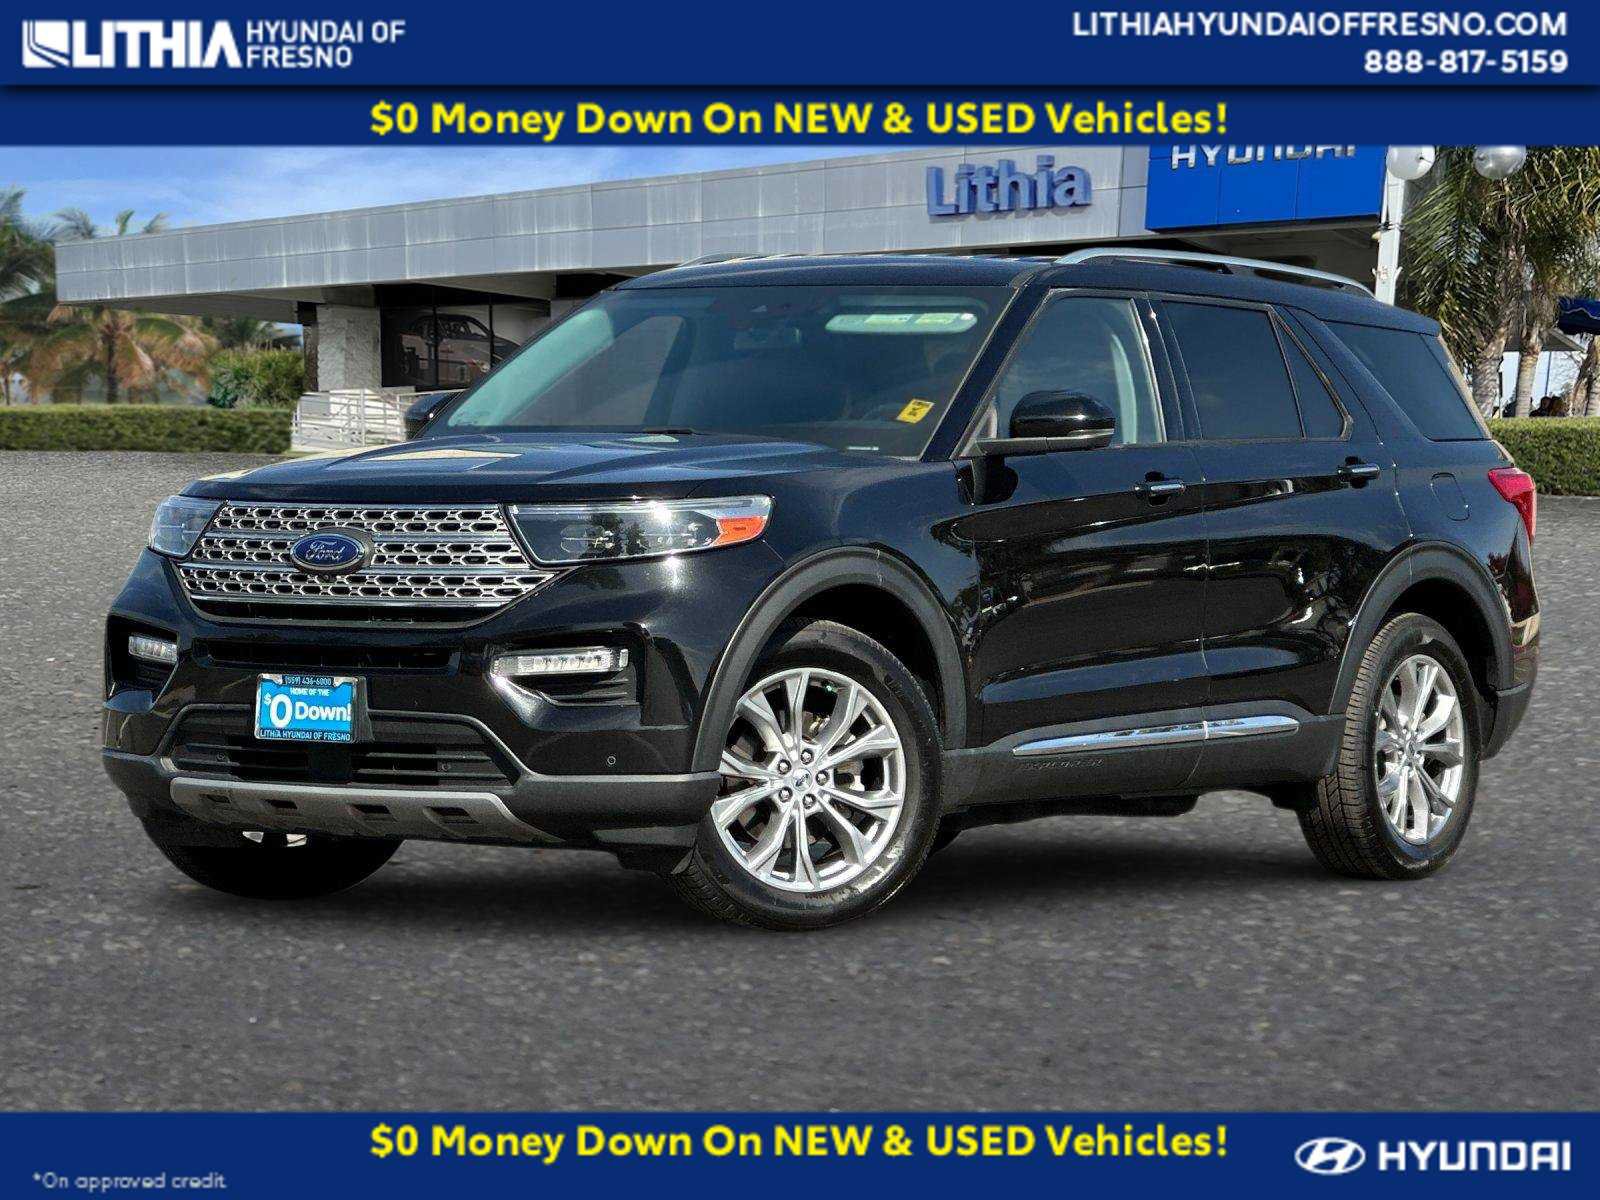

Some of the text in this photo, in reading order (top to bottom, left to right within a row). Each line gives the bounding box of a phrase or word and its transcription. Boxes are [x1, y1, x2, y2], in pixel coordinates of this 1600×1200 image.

[926, 155, 1093, 216] Lithia
[294, 701, 352, 721] Down!
[260, 729, 351, 741] LITHIA HYUNDAI OF FRESNO
